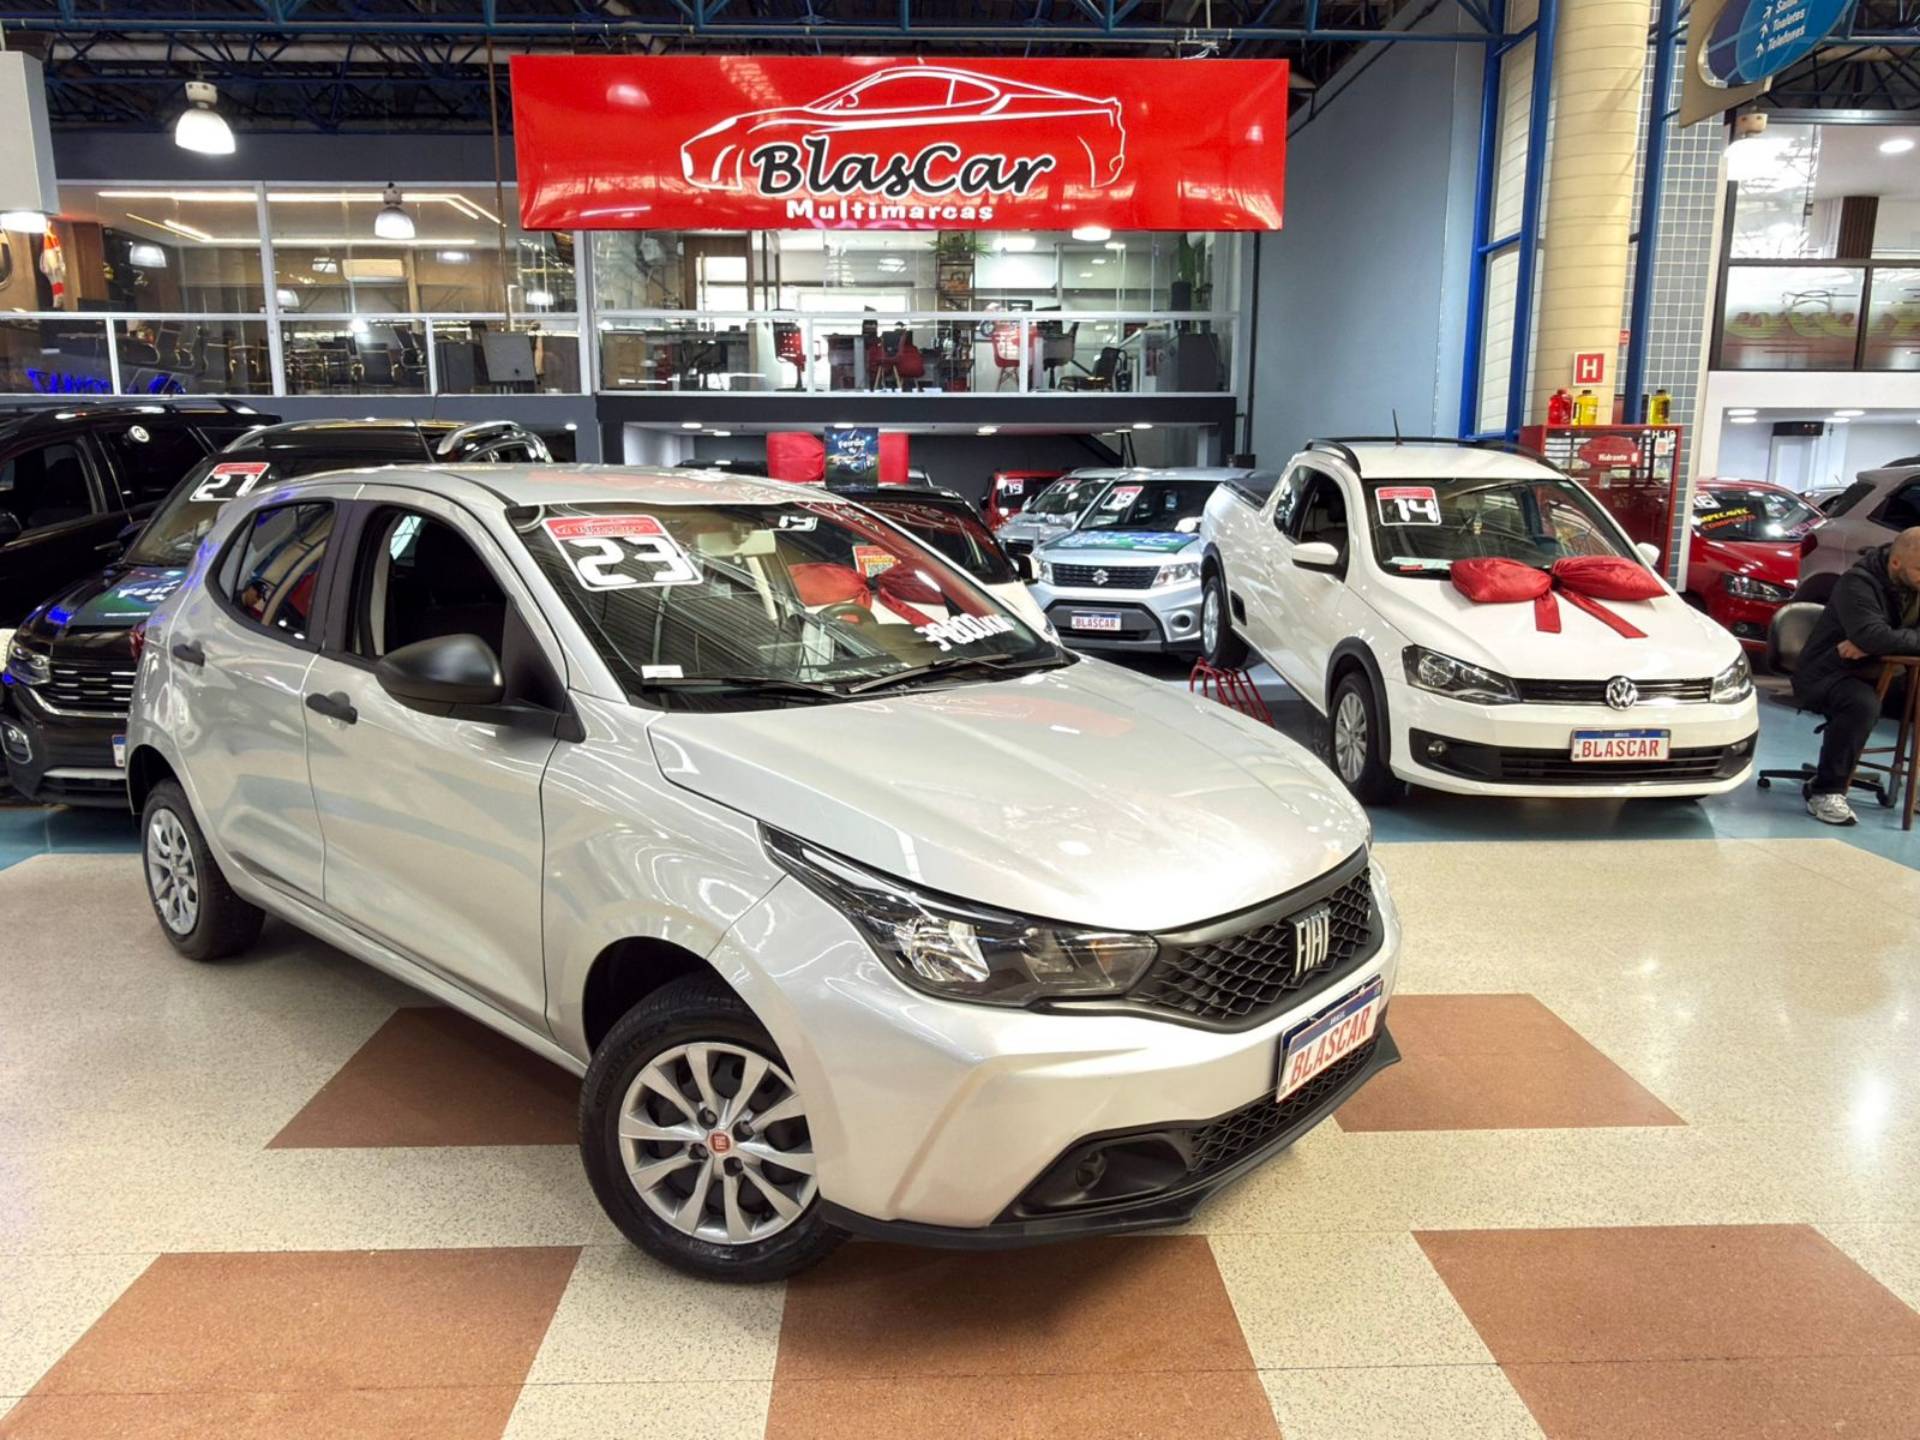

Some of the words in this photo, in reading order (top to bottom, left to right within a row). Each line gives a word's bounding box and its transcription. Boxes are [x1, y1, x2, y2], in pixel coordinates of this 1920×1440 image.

[751, 134, 1055, 196] BlasCar
[786, 200, 993, 220] Multimarcas
[1582, 358, 1597, 379] H
[1394, 498, 1438, 522] 14
[568, 536, 694, 586] 23
[1076, 618, 1116, 628] BLASCAR
[1581, 740, 1659, 758] BLASCAR
[1290, 1006, 1371, 1085] BLASCAR
